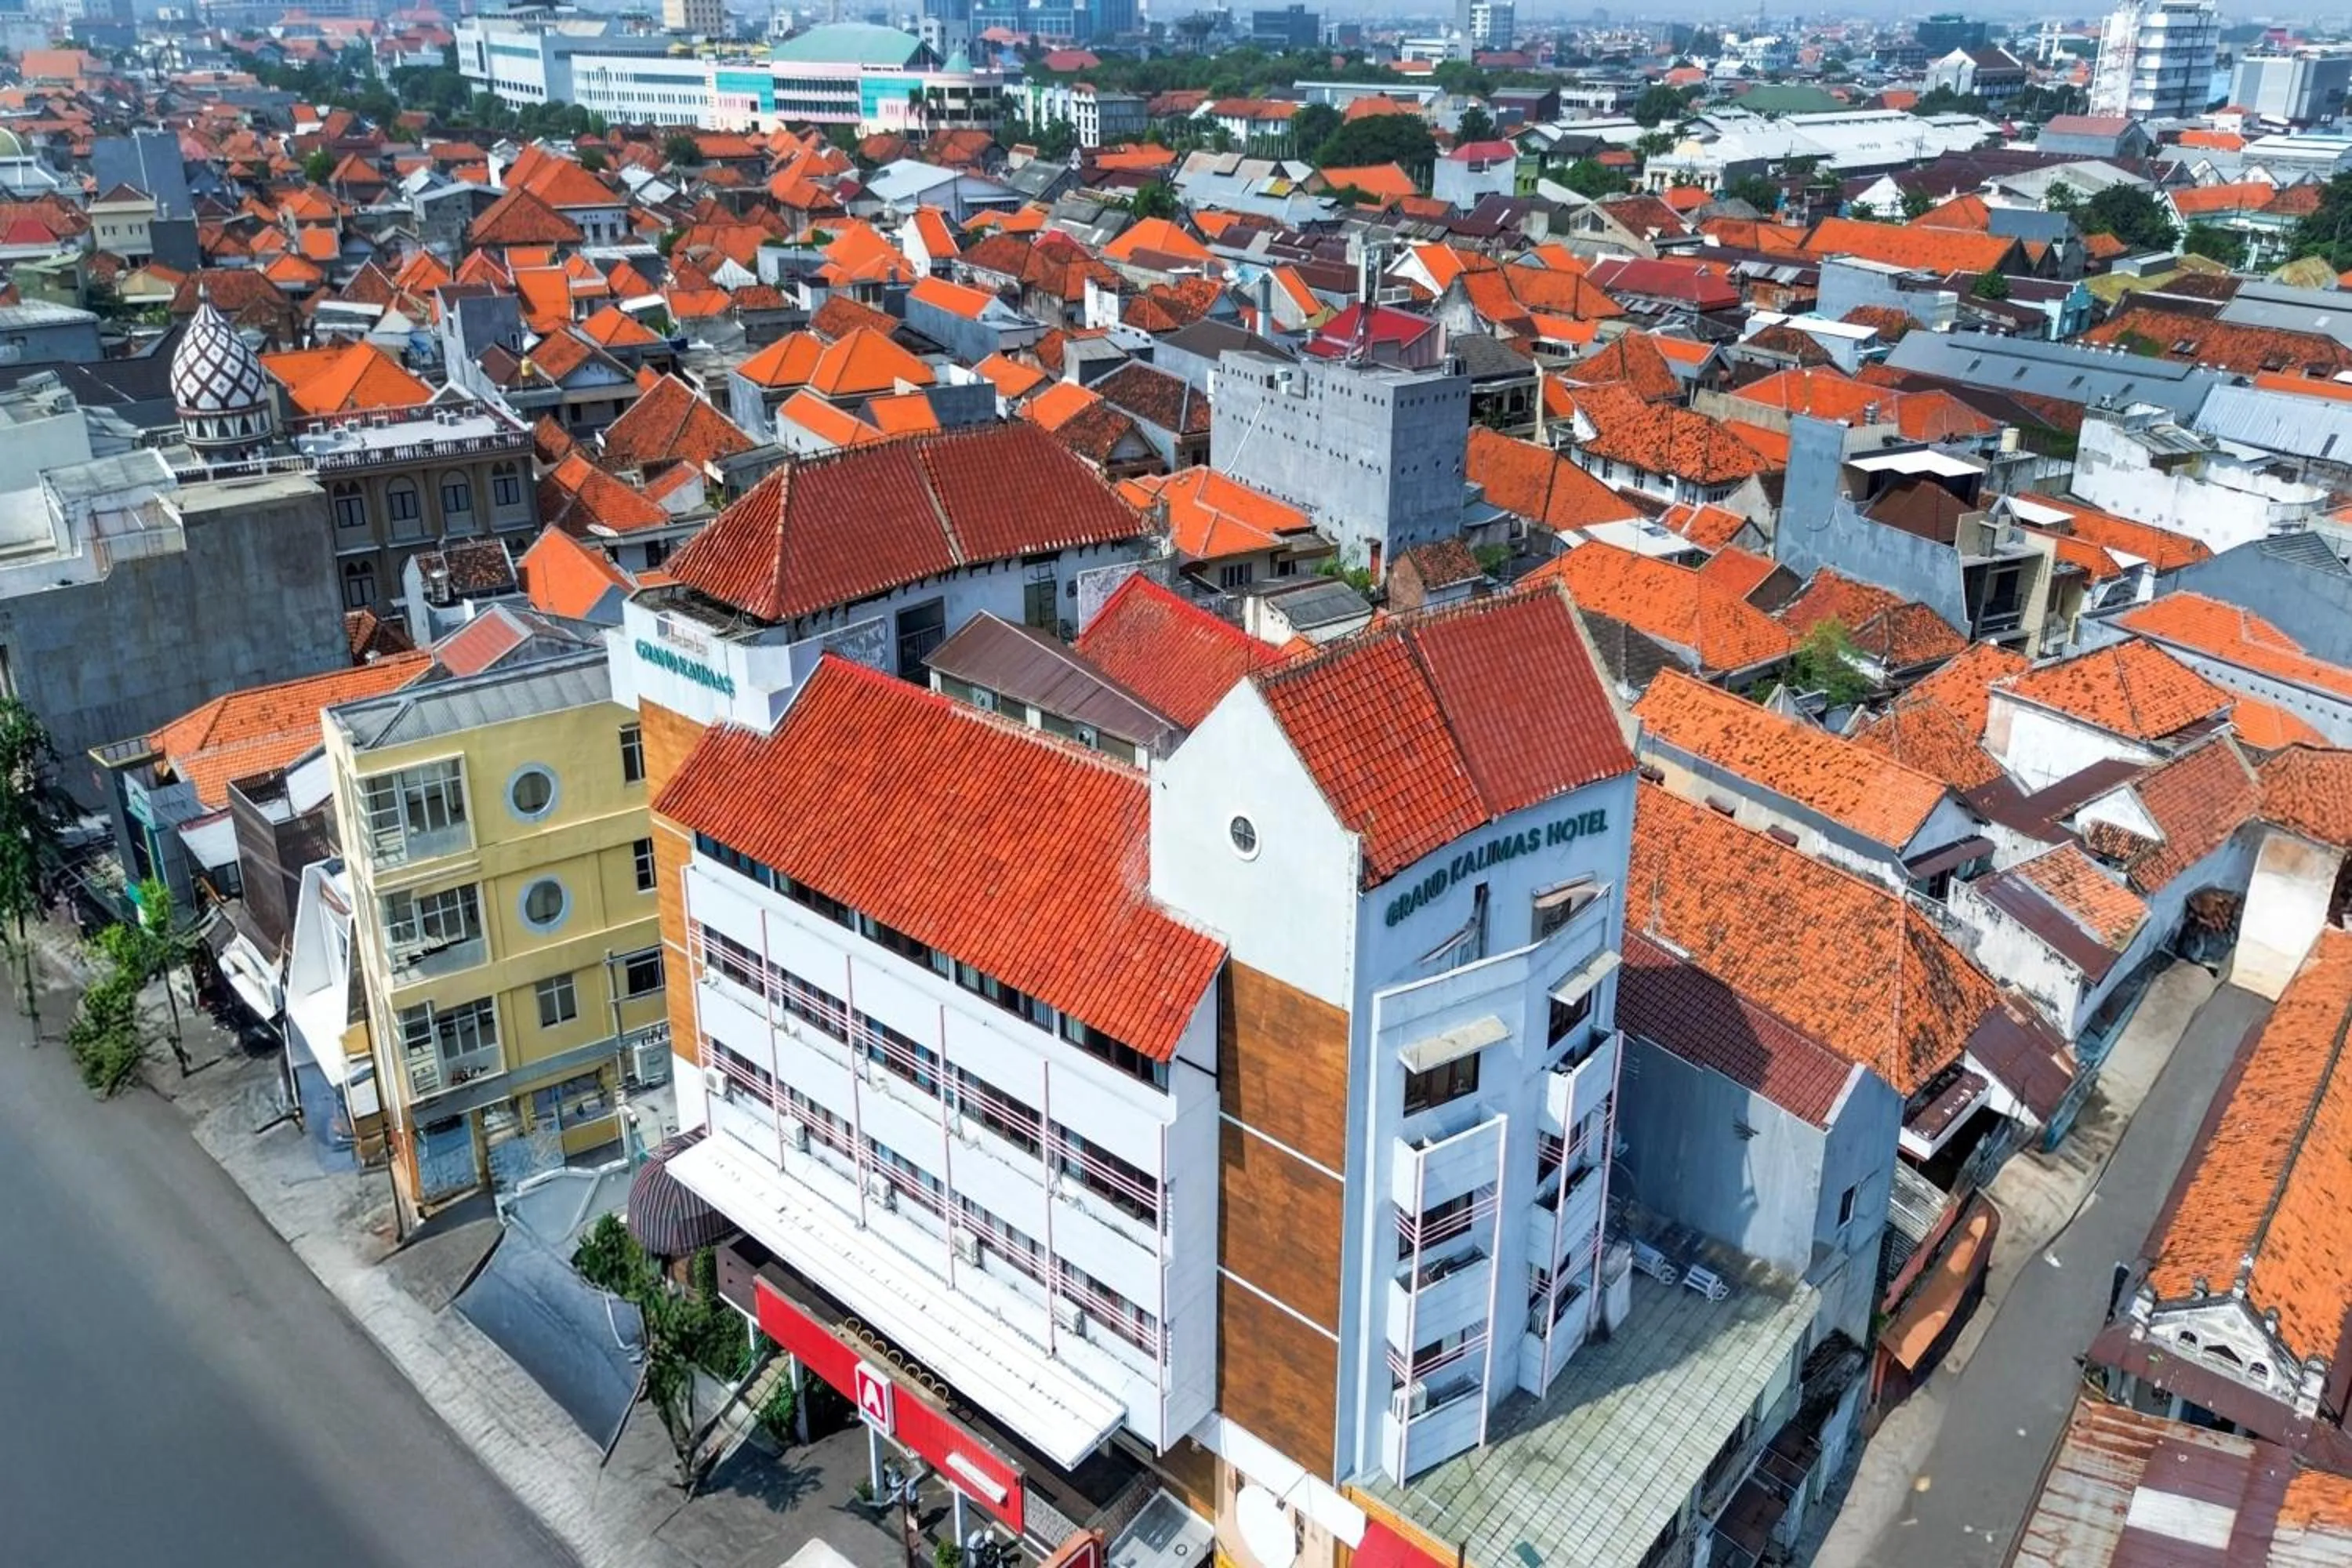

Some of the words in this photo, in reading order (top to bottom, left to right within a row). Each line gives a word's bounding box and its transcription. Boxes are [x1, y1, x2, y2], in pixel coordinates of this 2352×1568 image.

[1385, 868, 1447, 927] GRAND
[1450, 827, 1541, 885] KALIMAS
[1547, 808, 1609, 847] HOTEL
[863, 1378, 883, 1418] A
